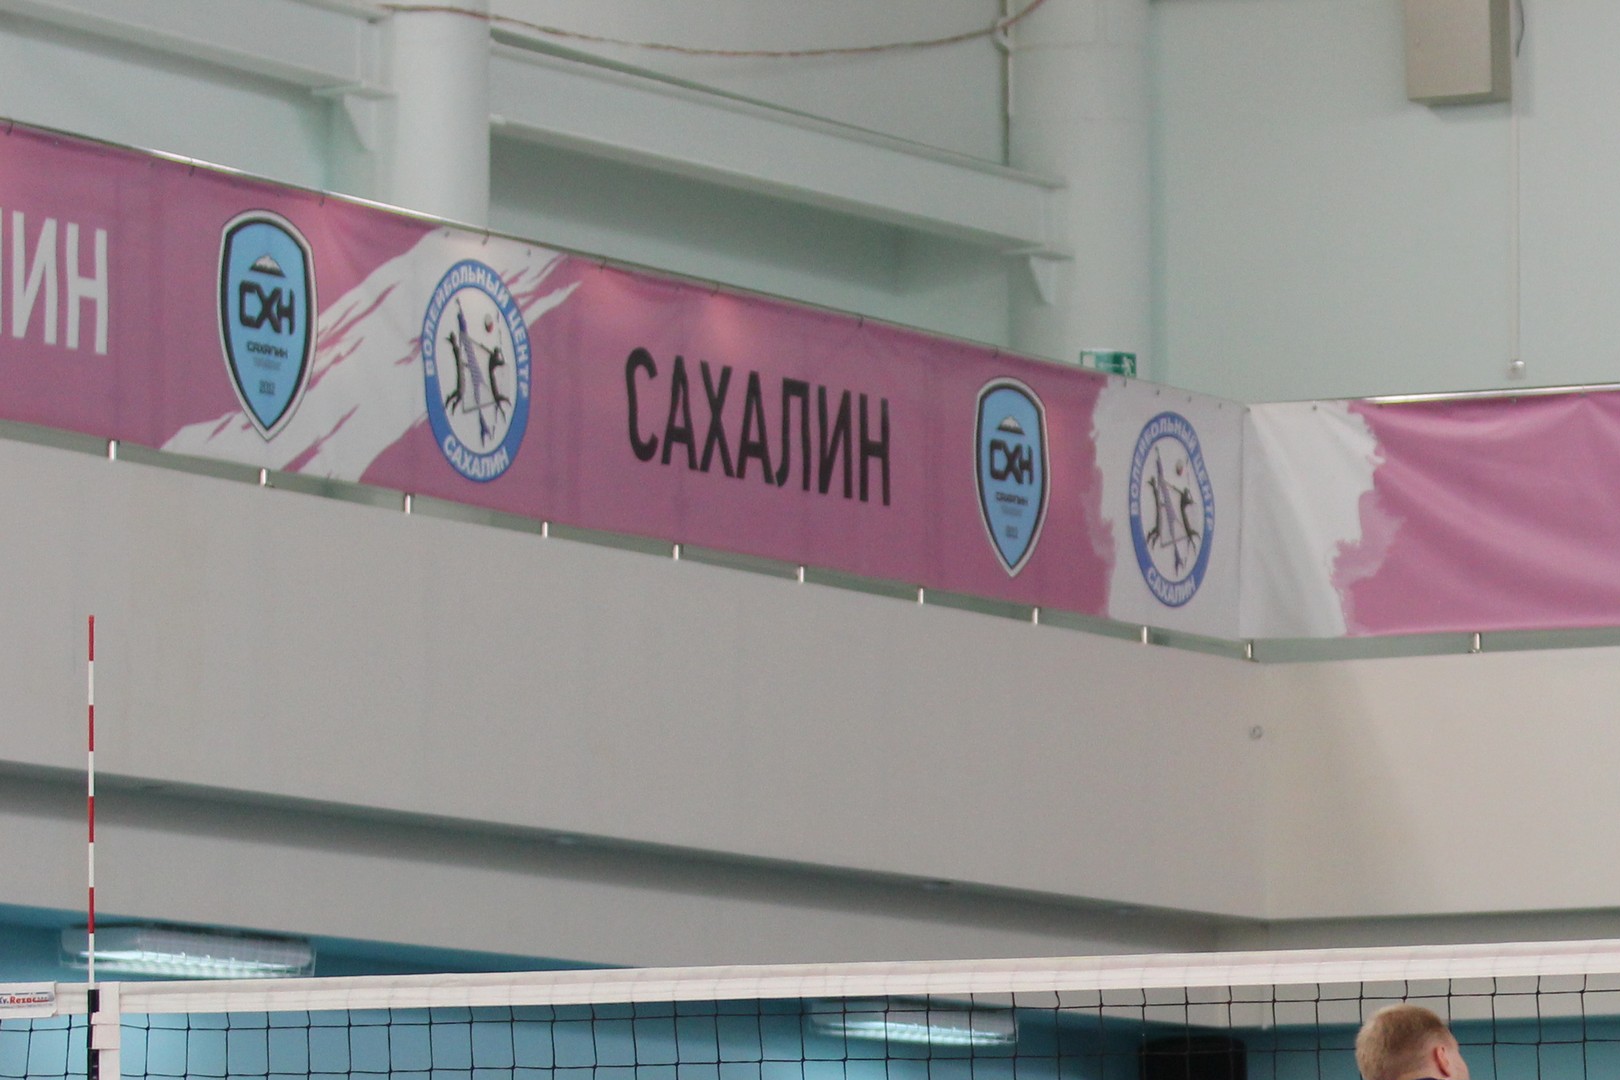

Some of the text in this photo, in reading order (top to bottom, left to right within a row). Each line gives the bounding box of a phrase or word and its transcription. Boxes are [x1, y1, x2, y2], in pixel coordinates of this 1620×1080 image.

[0, 206, 108, 356] ИН
[424, 264, 530, 398] ВОЛЕЙБОЛЬНЫЙ ЦЕНТР
[442, 434, 509, 478] САХАЛИН
[625, 347, 890, 506] САХАЛИН
